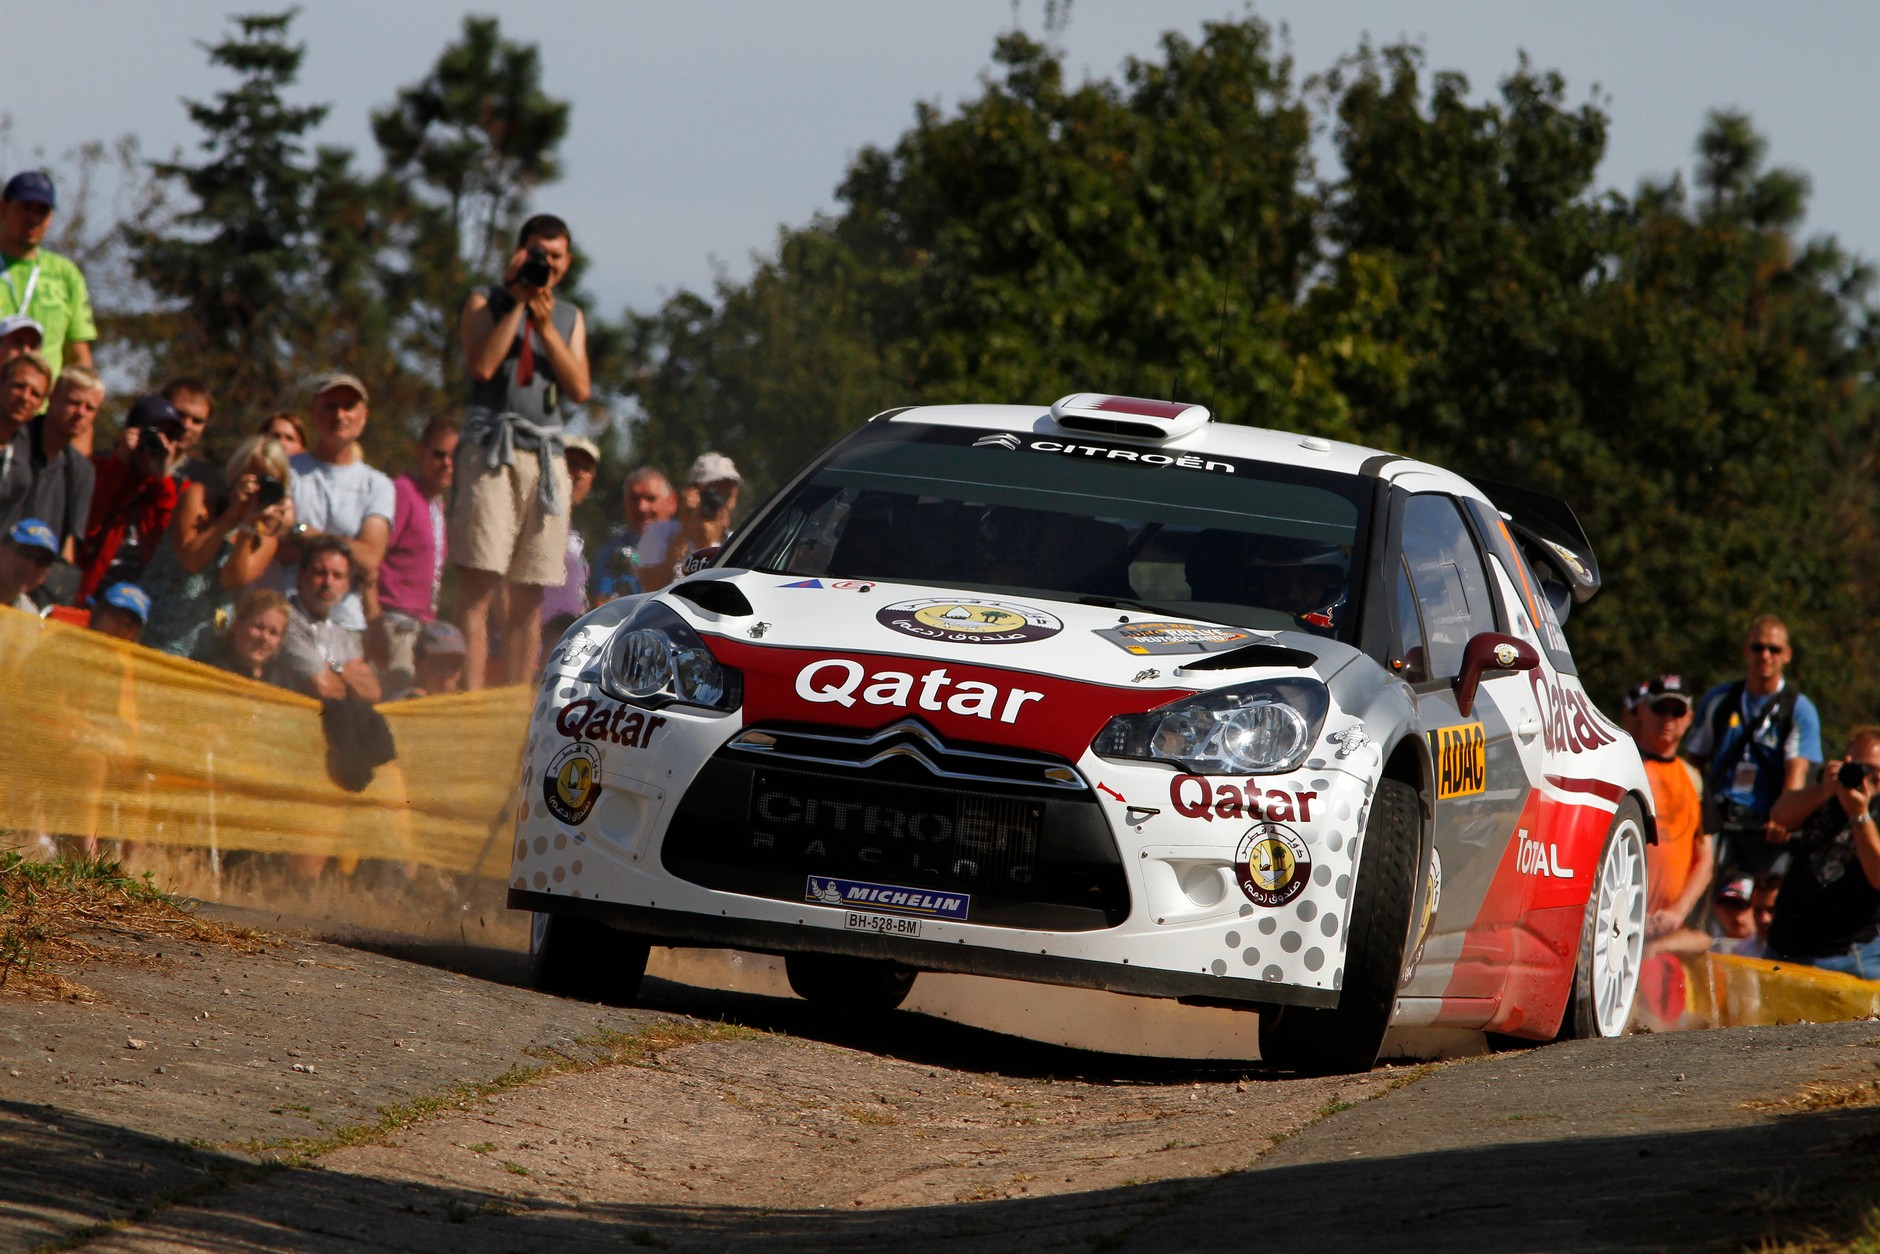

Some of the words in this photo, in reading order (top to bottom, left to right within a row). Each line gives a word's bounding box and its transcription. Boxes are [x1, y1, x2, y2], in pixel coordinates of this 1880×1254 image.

[1118, 629, 1166, 638] ADAC
[1164, 628, 1224, 637] RALLYE
[1132, 634, 1226, 643] DEUTSCHLAND
[795, 659, 1045, 724] Qatar
[1529, 667, 1617, 758] Qatar
[556, 697, 667, 749] Qatar
[1440, 726, 1484, 796] ADAC
[1170, 774, 1317, 823] Qatar
[1516, 828, 1574, 878] TOTAL
[847, 887, 961, 911] MICHELIN
[849, 913, 917, 934] BH-528-BM
